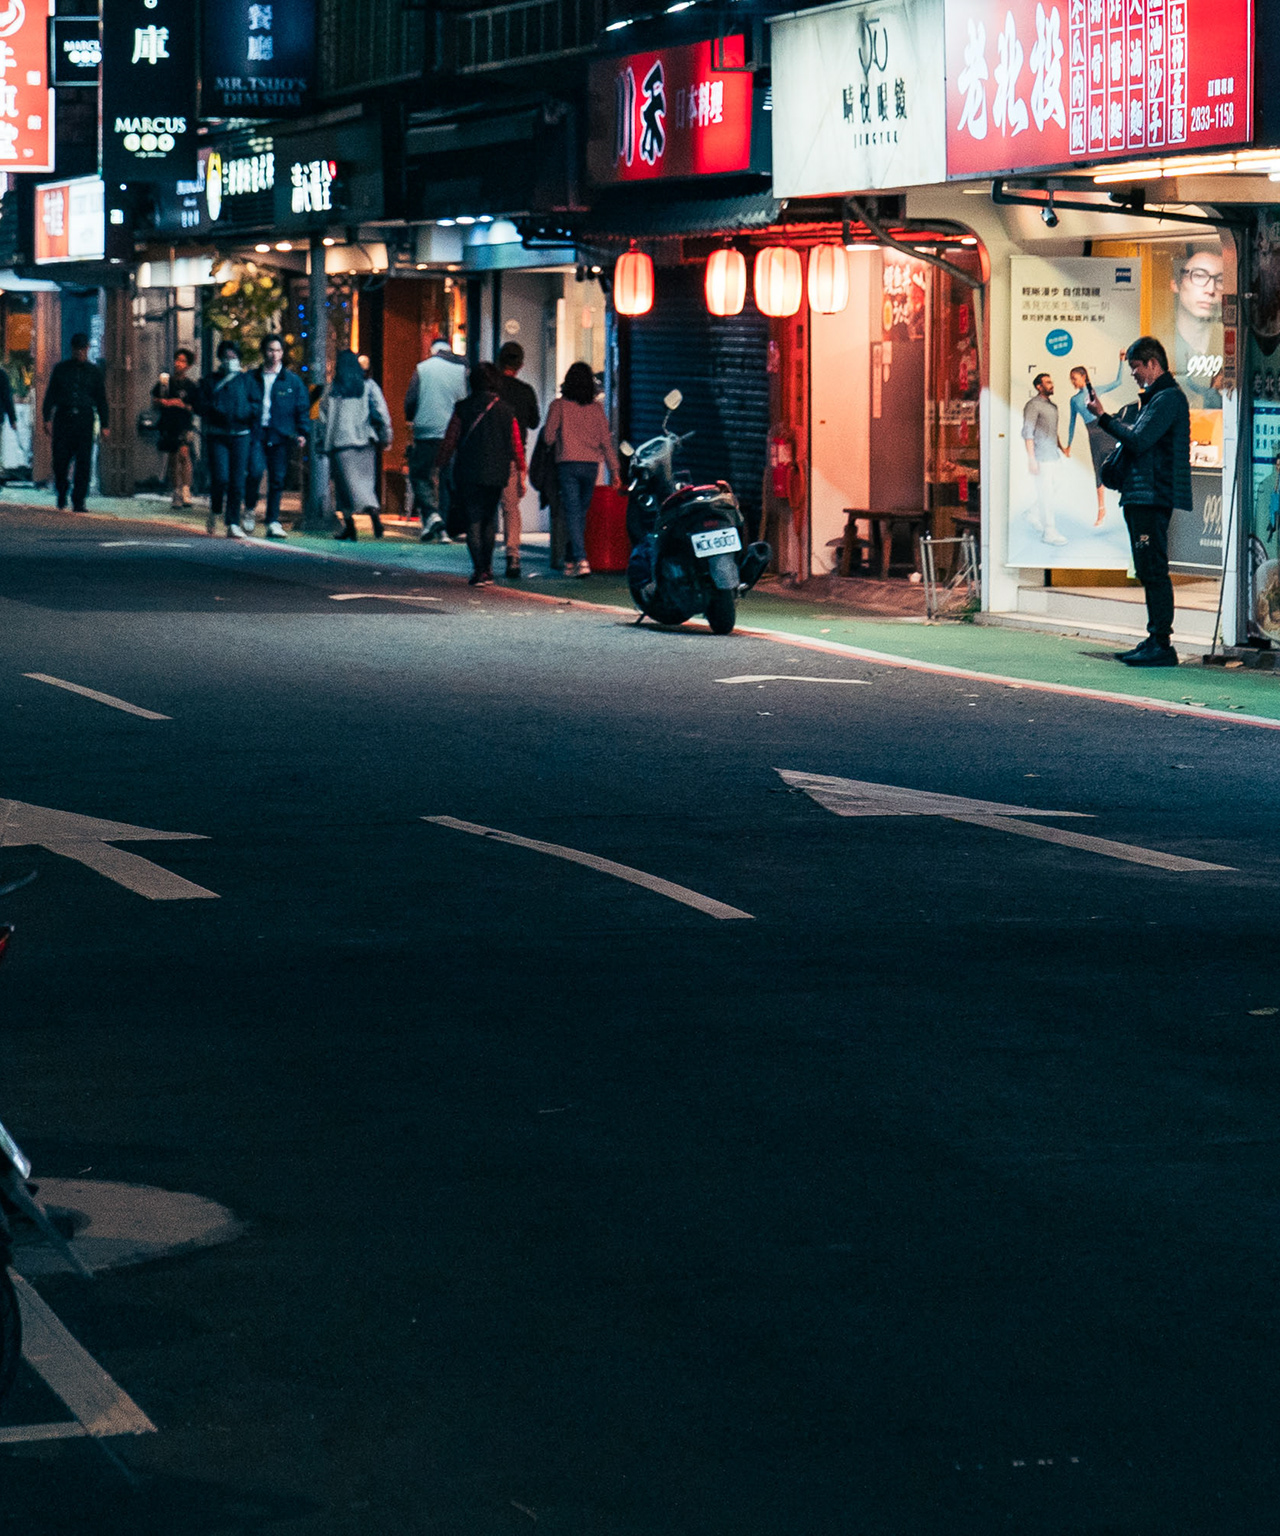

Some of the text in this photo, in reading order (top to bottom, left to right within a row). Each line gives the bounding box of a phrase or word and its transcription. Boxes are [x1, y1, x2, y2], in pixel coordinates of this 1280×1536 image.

[957, 2, 1067, 141] 老北投
[675, 81, 724, 129] 日本料理
[1190, 101, 1235, 132] 2833-1158
[114, 117, 187, 133] MARCUS
